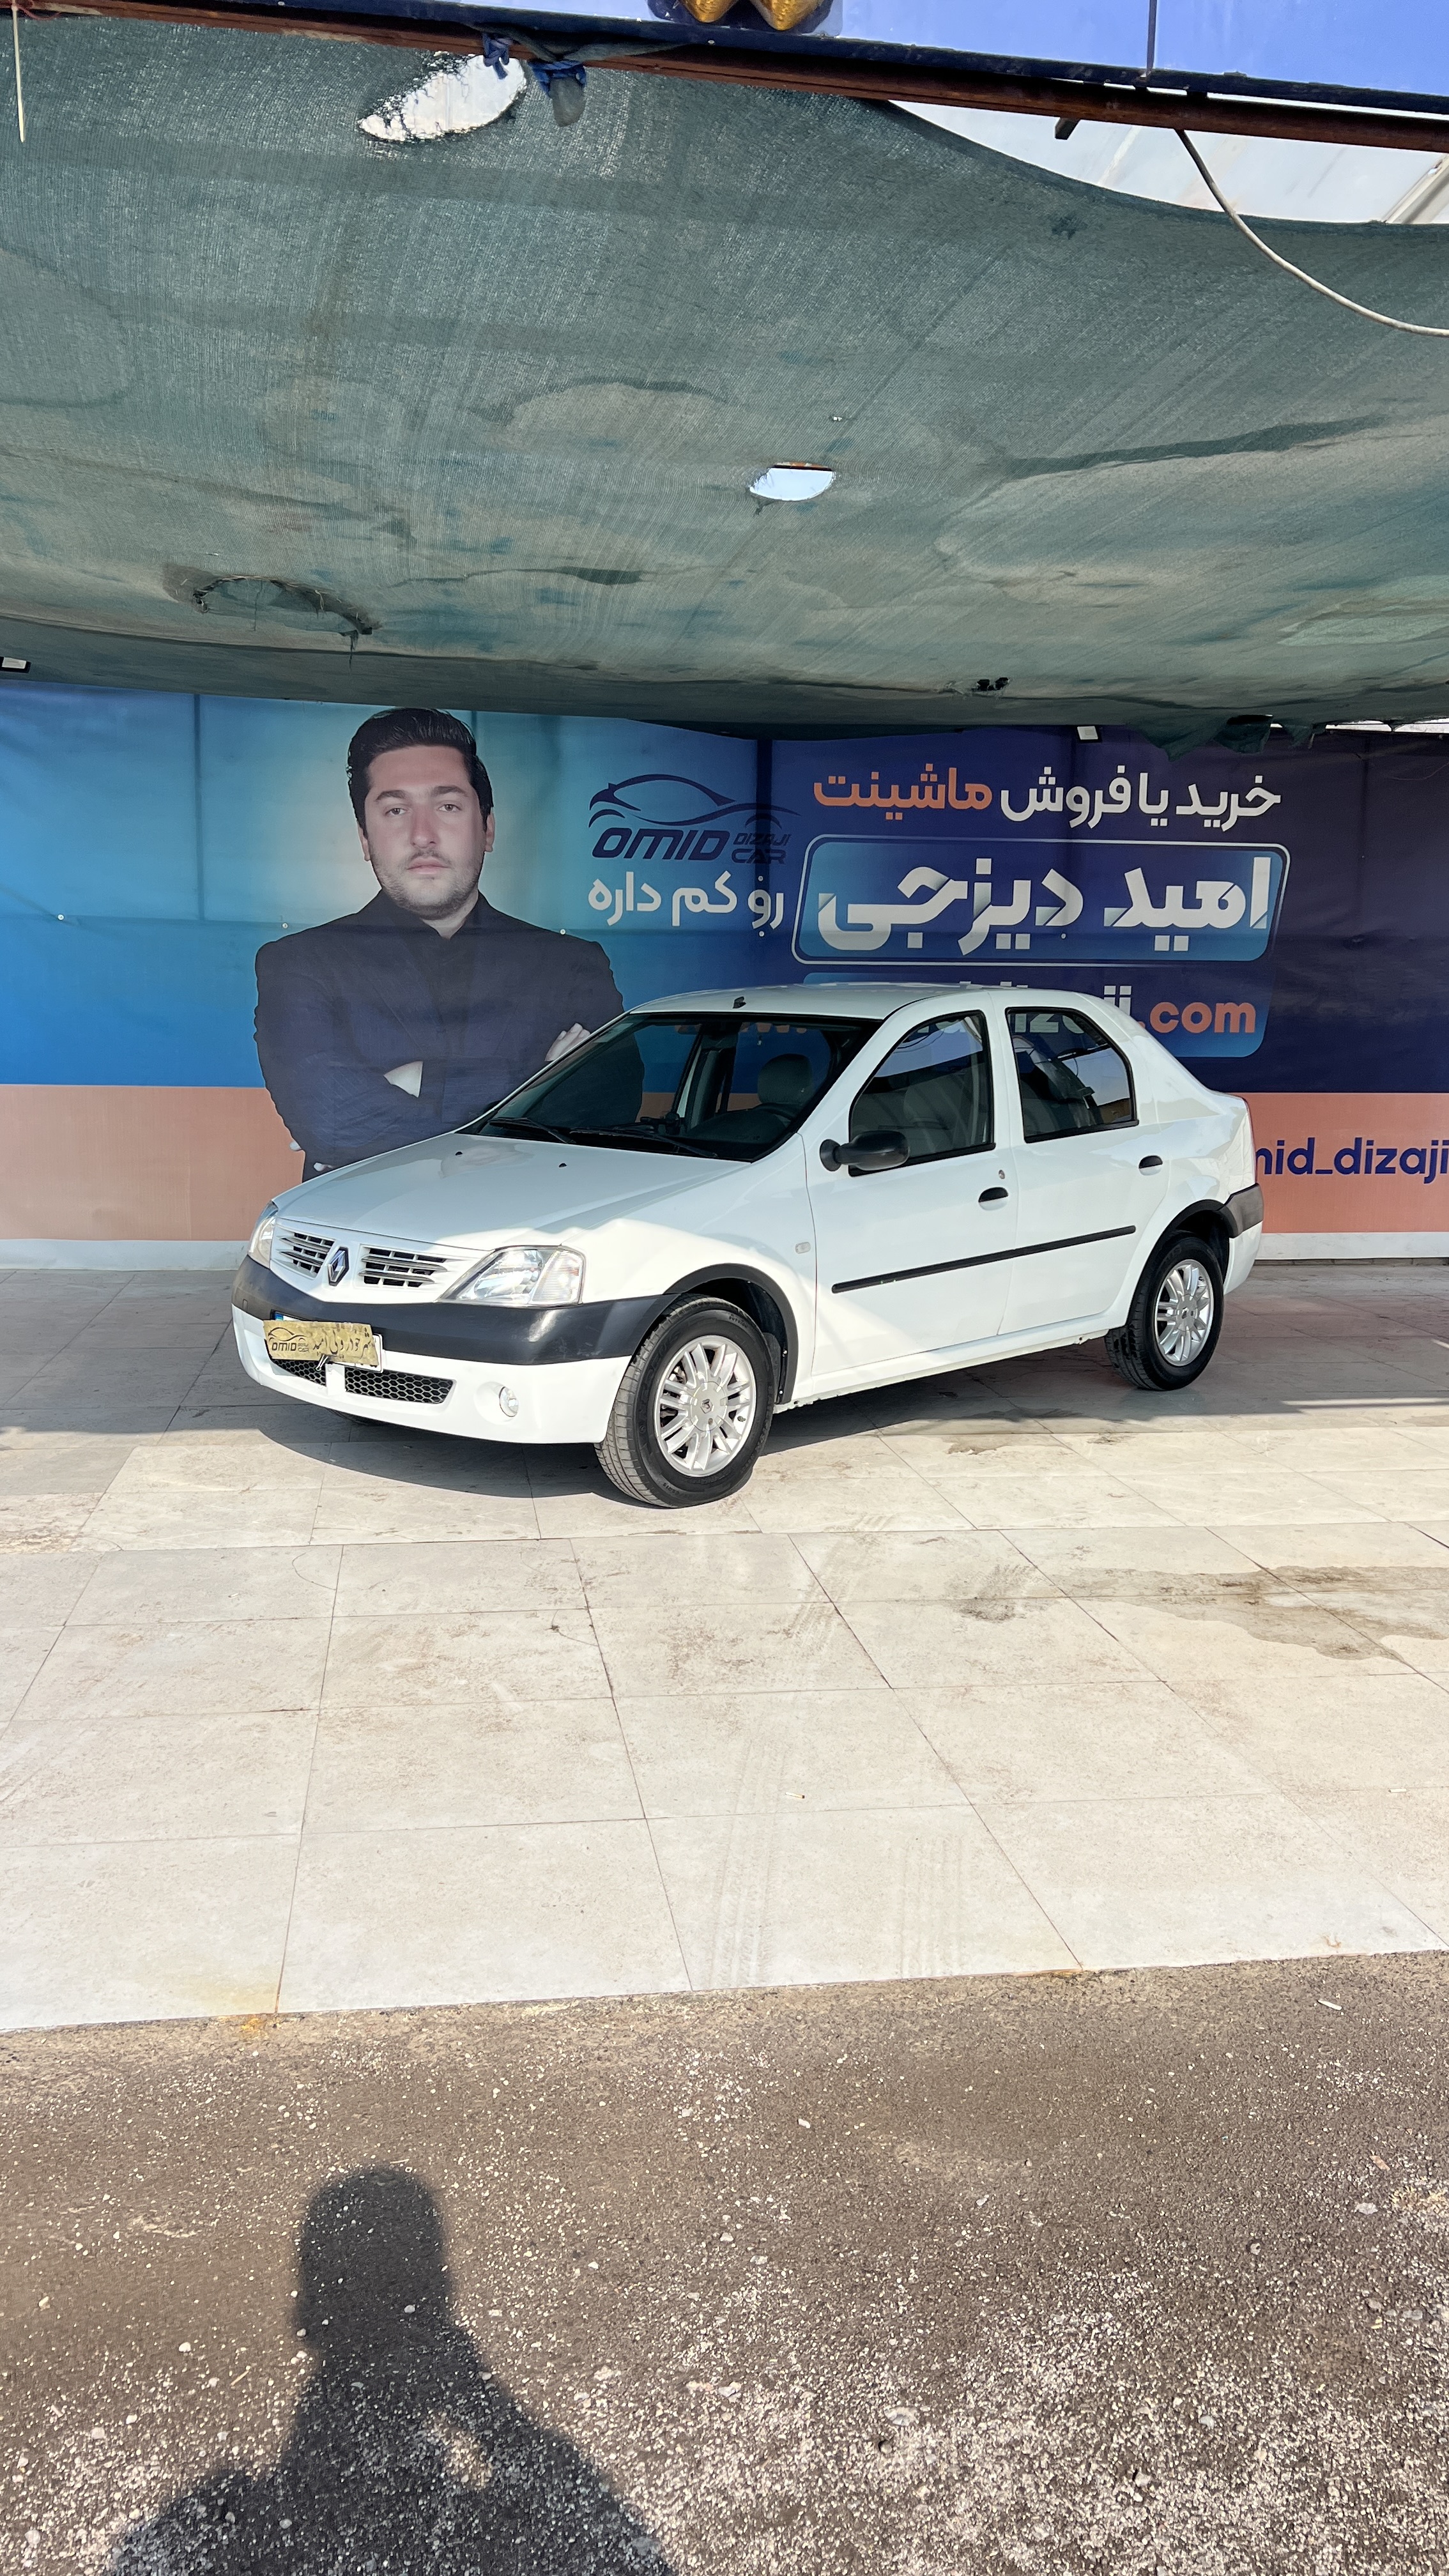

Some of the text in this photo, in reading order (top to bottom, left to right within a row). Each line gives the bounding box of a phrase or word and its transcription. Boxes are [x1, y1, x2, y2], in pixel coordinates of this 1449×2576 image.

[813, 763, 1281, 831] خرید یا فروش ماشینت
[592, 827, 731, 861] OMID
[731, 848, 786, 864] CAR
[588, 870, 785, 930] رو کم داره
[818, 857, 1271, 956] امید دیزجی
[271, 1342, 297, 1352] OMID
